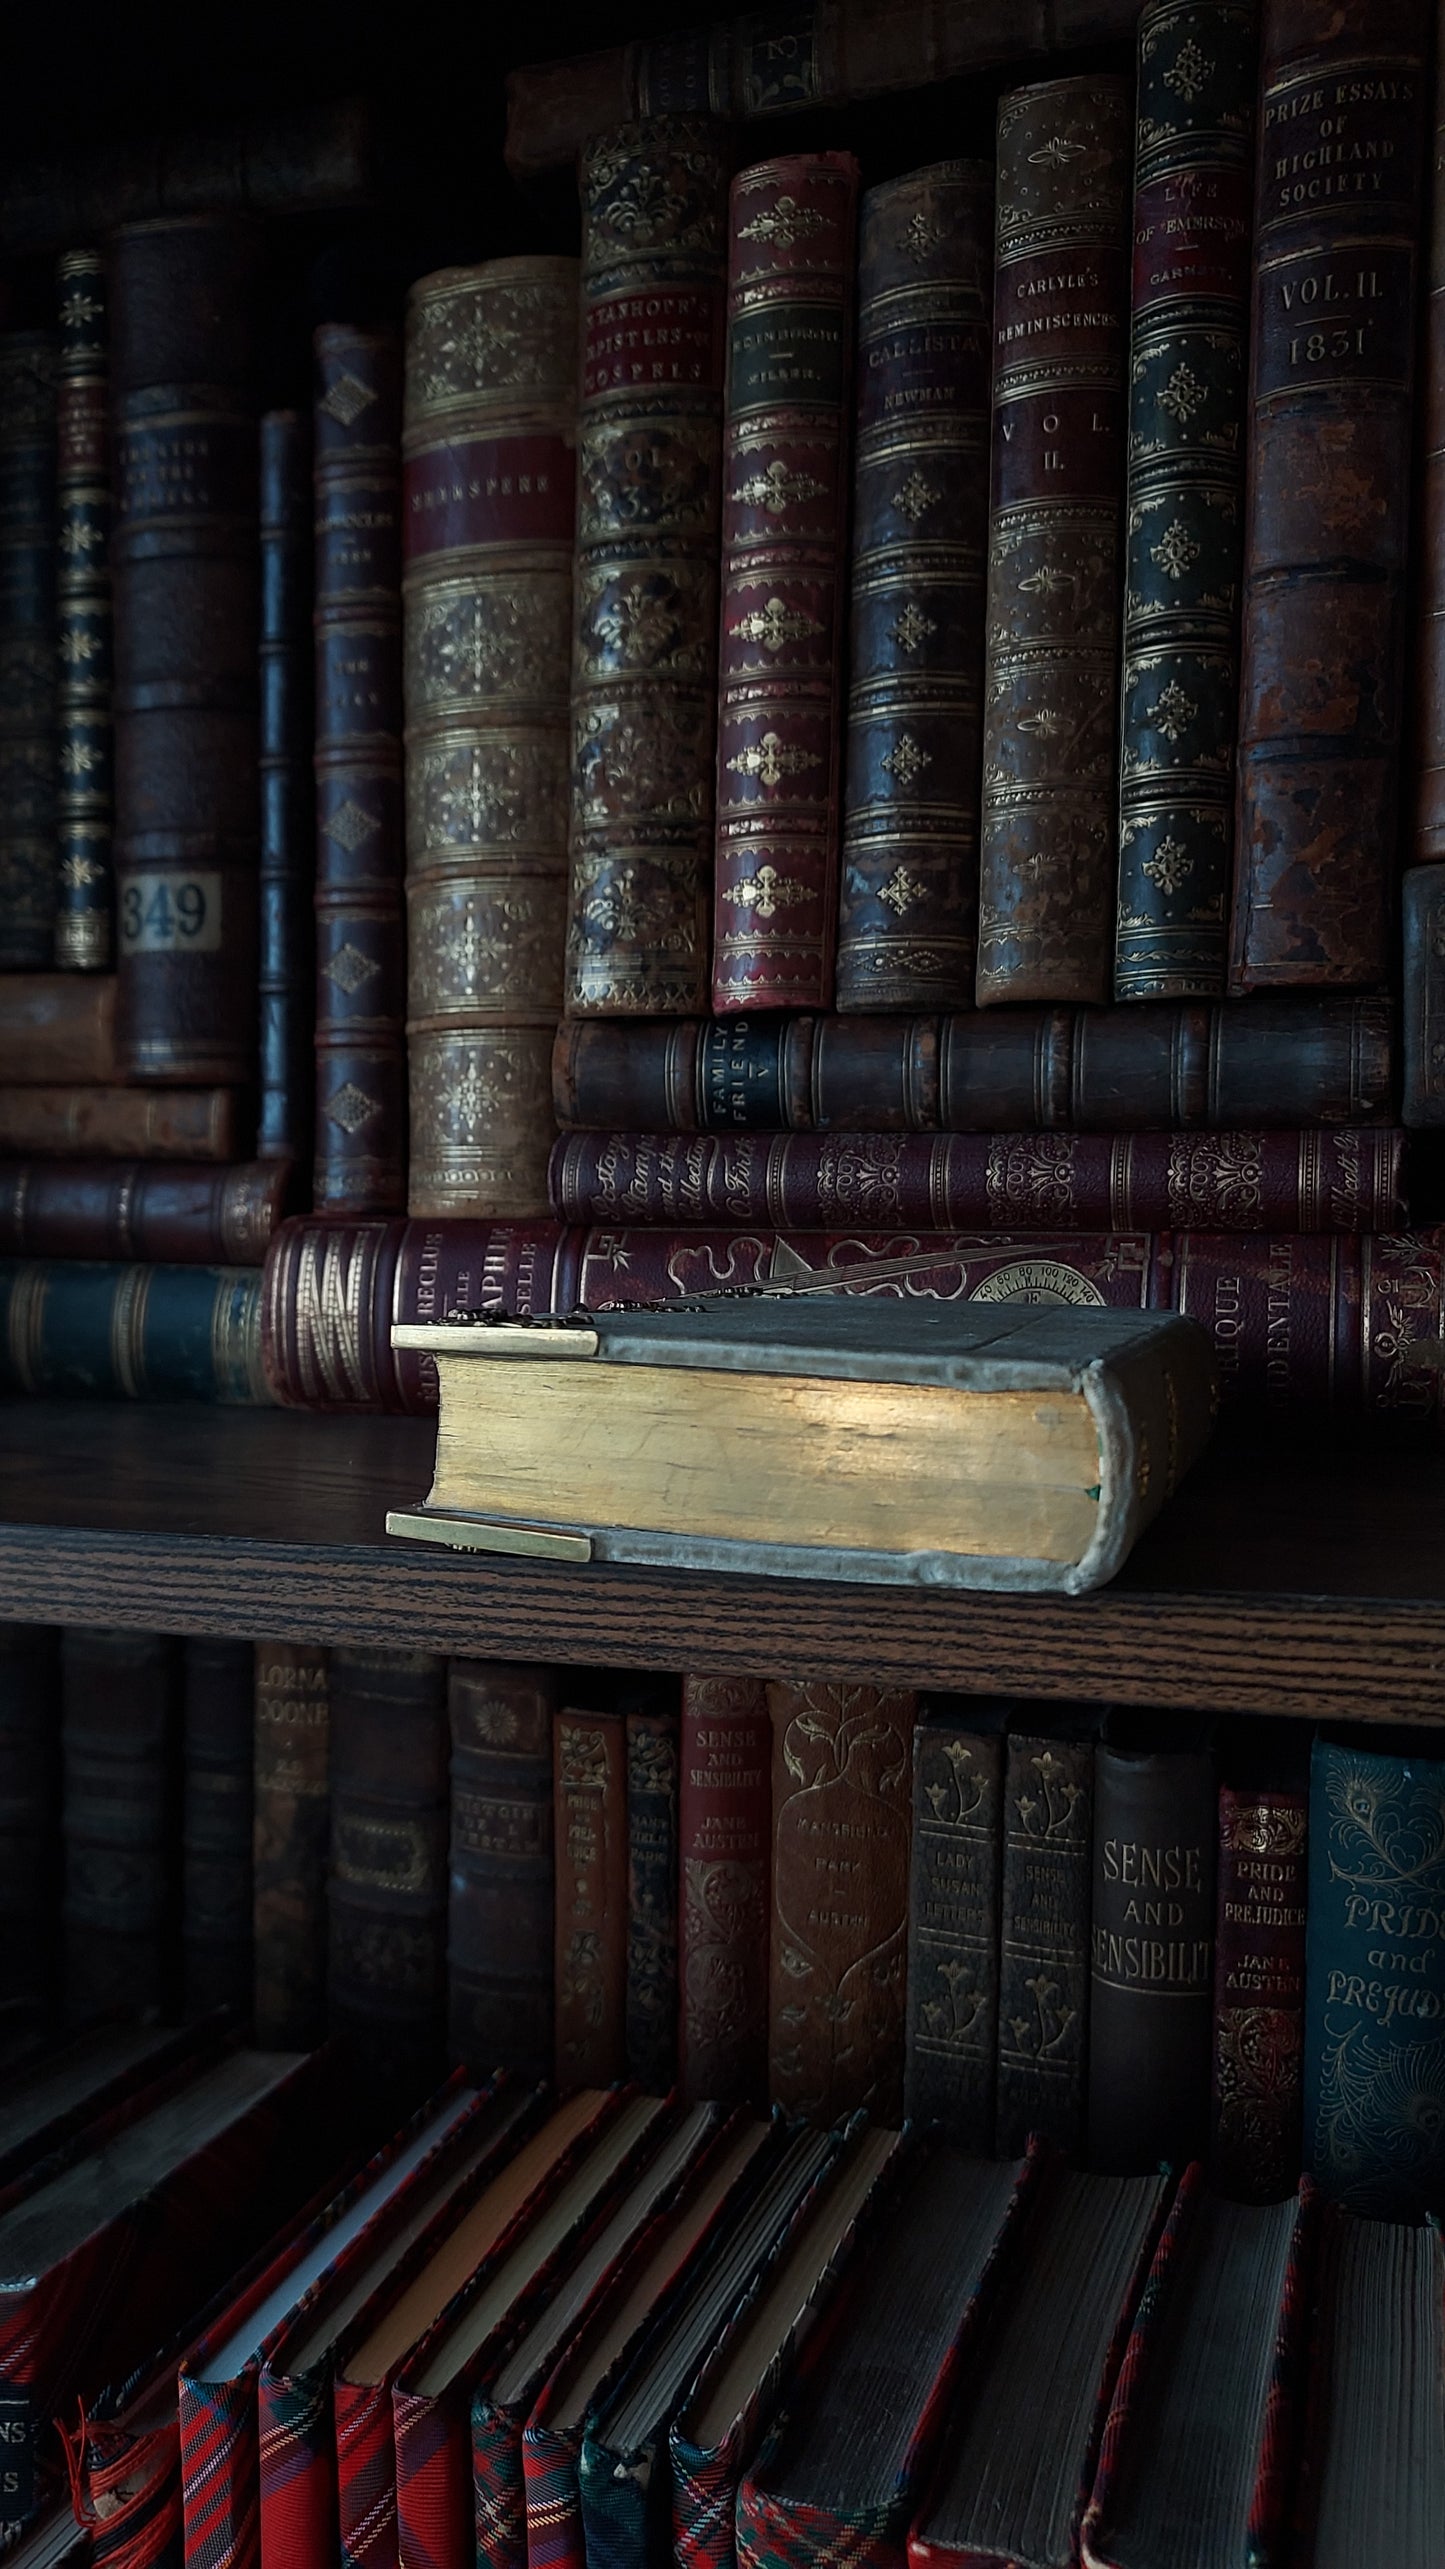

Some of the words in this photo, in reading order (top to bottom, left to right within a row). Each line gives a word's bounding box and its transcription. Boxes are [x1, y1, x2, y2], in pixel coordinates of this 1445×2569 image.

[1265, 88, 1324, 128] PRIZE
[1335, 80, 1414, 105] ESSAYS
[1319, 115, 1348, 138] OF
[1275, 139, 1395, 180] HIGHLAND
[1165, 183, 1217, 202] LIFE
[1279, 172, 1385, 207] SOCIETY
[1136, 225, 1155, 245] OF
[1017, 267, 1099, 298] CARLYLE'S
[869, 336, 982, 368] CALLISTA
[1289, 328, 1365, 365] 1831
[884, 387, 956, 411] NEWMAN
[125, 882, 206, 939] 349
[711, 1026, 728, 1115] FAMILY
[730, 1021, 749, 1121] FRIEND
[757, 1066, 769, 1078] V
[590, 1134, 630, 1221] Postage
[677, 1135, 708, 1220] Collection
[723, 1136, 757, 1197] Firth
[656, 1179, 679, 1218] and
[416, 1233, 443, 1315] RECLUS
[996, 1272, 1011, 1286] 60
[1018, 1266, 1033, 1277] 80
[1041, 1266, 1059, 1278] 100
[1062, 1272, 1079, 1287] 120
[980, 1285, 993, 1299] 40
[1079, 1286, 1094, 1303] 140
[416, 1351, 438, 1404] ÉLIS
[257, 1663, 328, 1691] LORNA
[257, 1698, 329, 1726] DOONE
[696, 1730, 756, 1748] SENSE
[707, 1753, 743, 1767] AND
[690, 1769, 761, 1788] SENSIBILITY
[701, 1817, 747, 1830] JANE
[692, 1832, 760, 1850] AUSTEN
[815, 1857, 861, 1872] PARK
[936, 1851, 975, 1870] LADY
[1103, 1838, 1200, 1893] SENSE
[1237, 1861, 1297, 1882] PRIDE
[1025, 1865, 1066, 1884] SENSE
[930, 1876, 984, 1898] SUSAN
[1248, 1885, 1285, 1902] AND
[925, 1902, 986, 1921] LETTERS
[1031, 1893, 1057, 1911] AND
[1123, 1900, 1184, 1926] AND
[1225, 1902, 1305, 1927] PREJUDICE
[1237, 1953, 1291, 1971] JANE
[1367, 1949, 1436, 1974] and
[1225, 1972, 1300, 1993] AUSTEN
